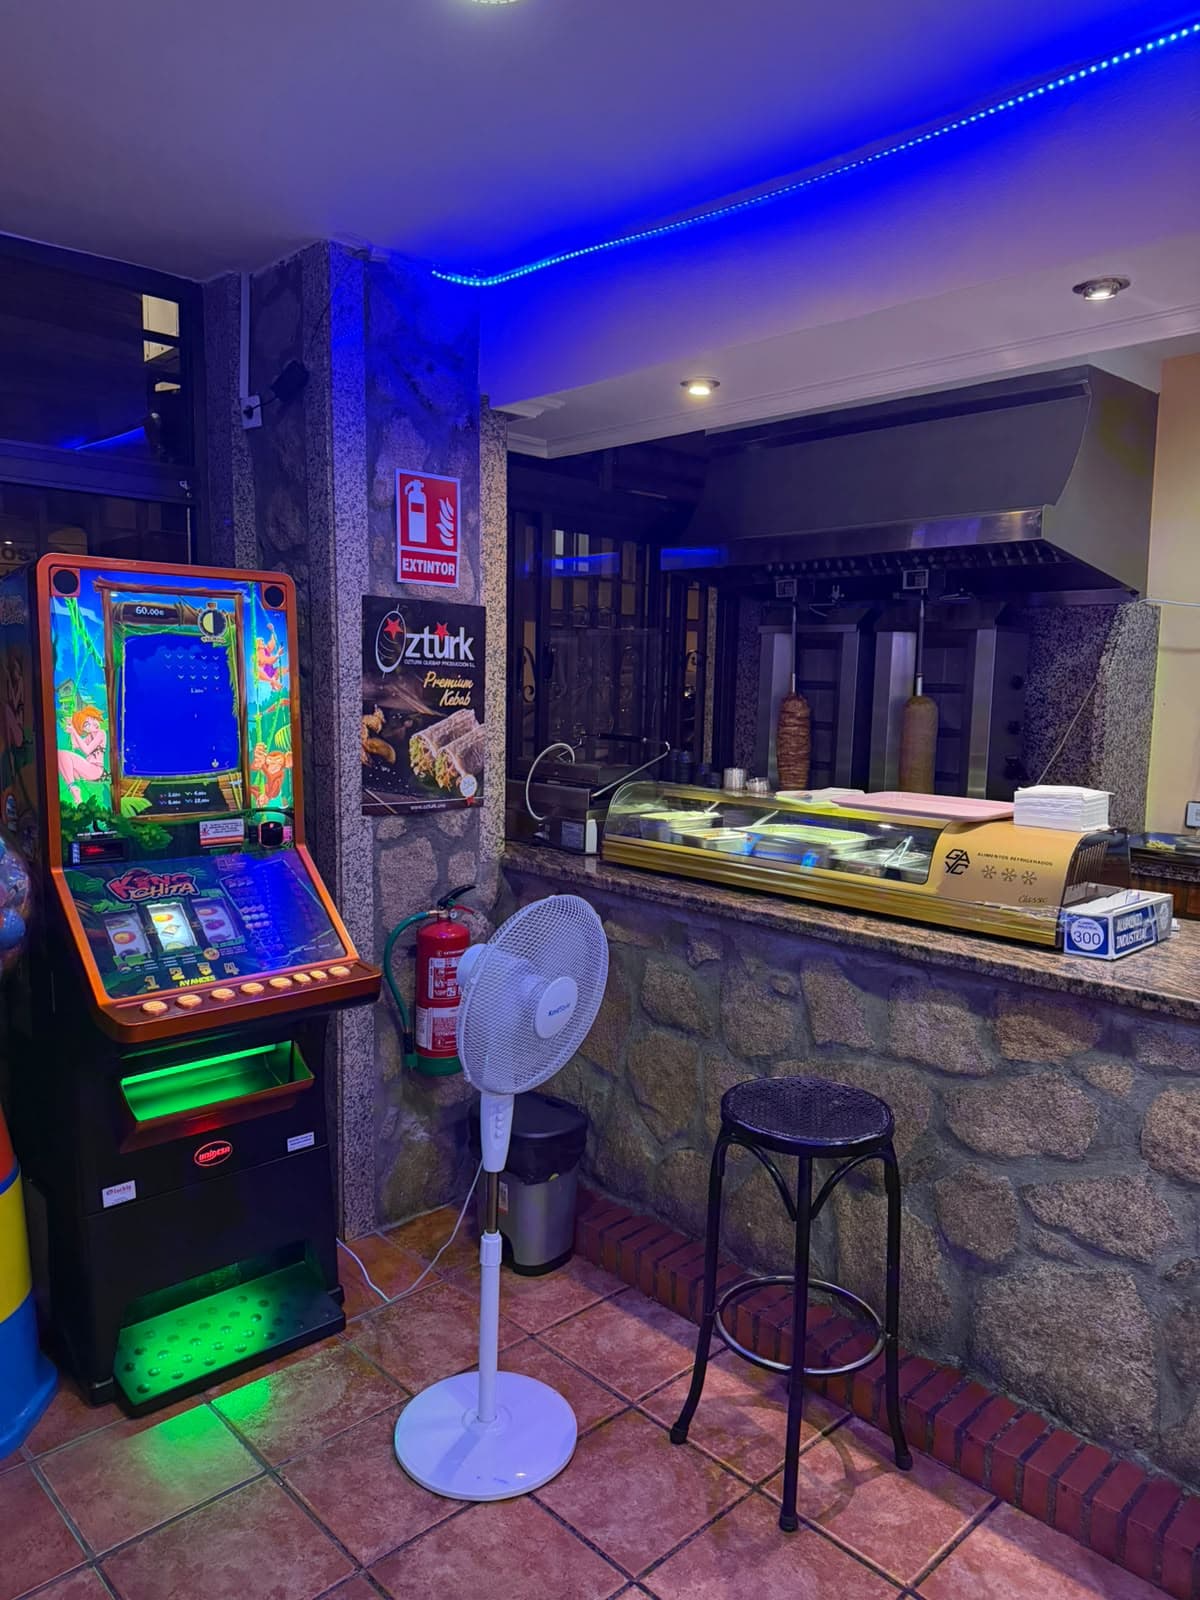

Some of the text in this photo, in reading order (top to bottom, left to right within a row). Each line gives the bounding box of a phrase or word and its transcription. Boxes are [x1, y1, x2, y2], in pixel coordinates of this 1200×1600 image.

[402, 557, 456, 576] EXTINTOR
[423, 671, 474, 689] Premium
[439, 689, 471, 706] Kebab
[1073, 931, 1101, 946] 300
[144, 975, 160, 990] 1
[168, 967, 185, 981] 2
[223, 961, 240, 975] 4
